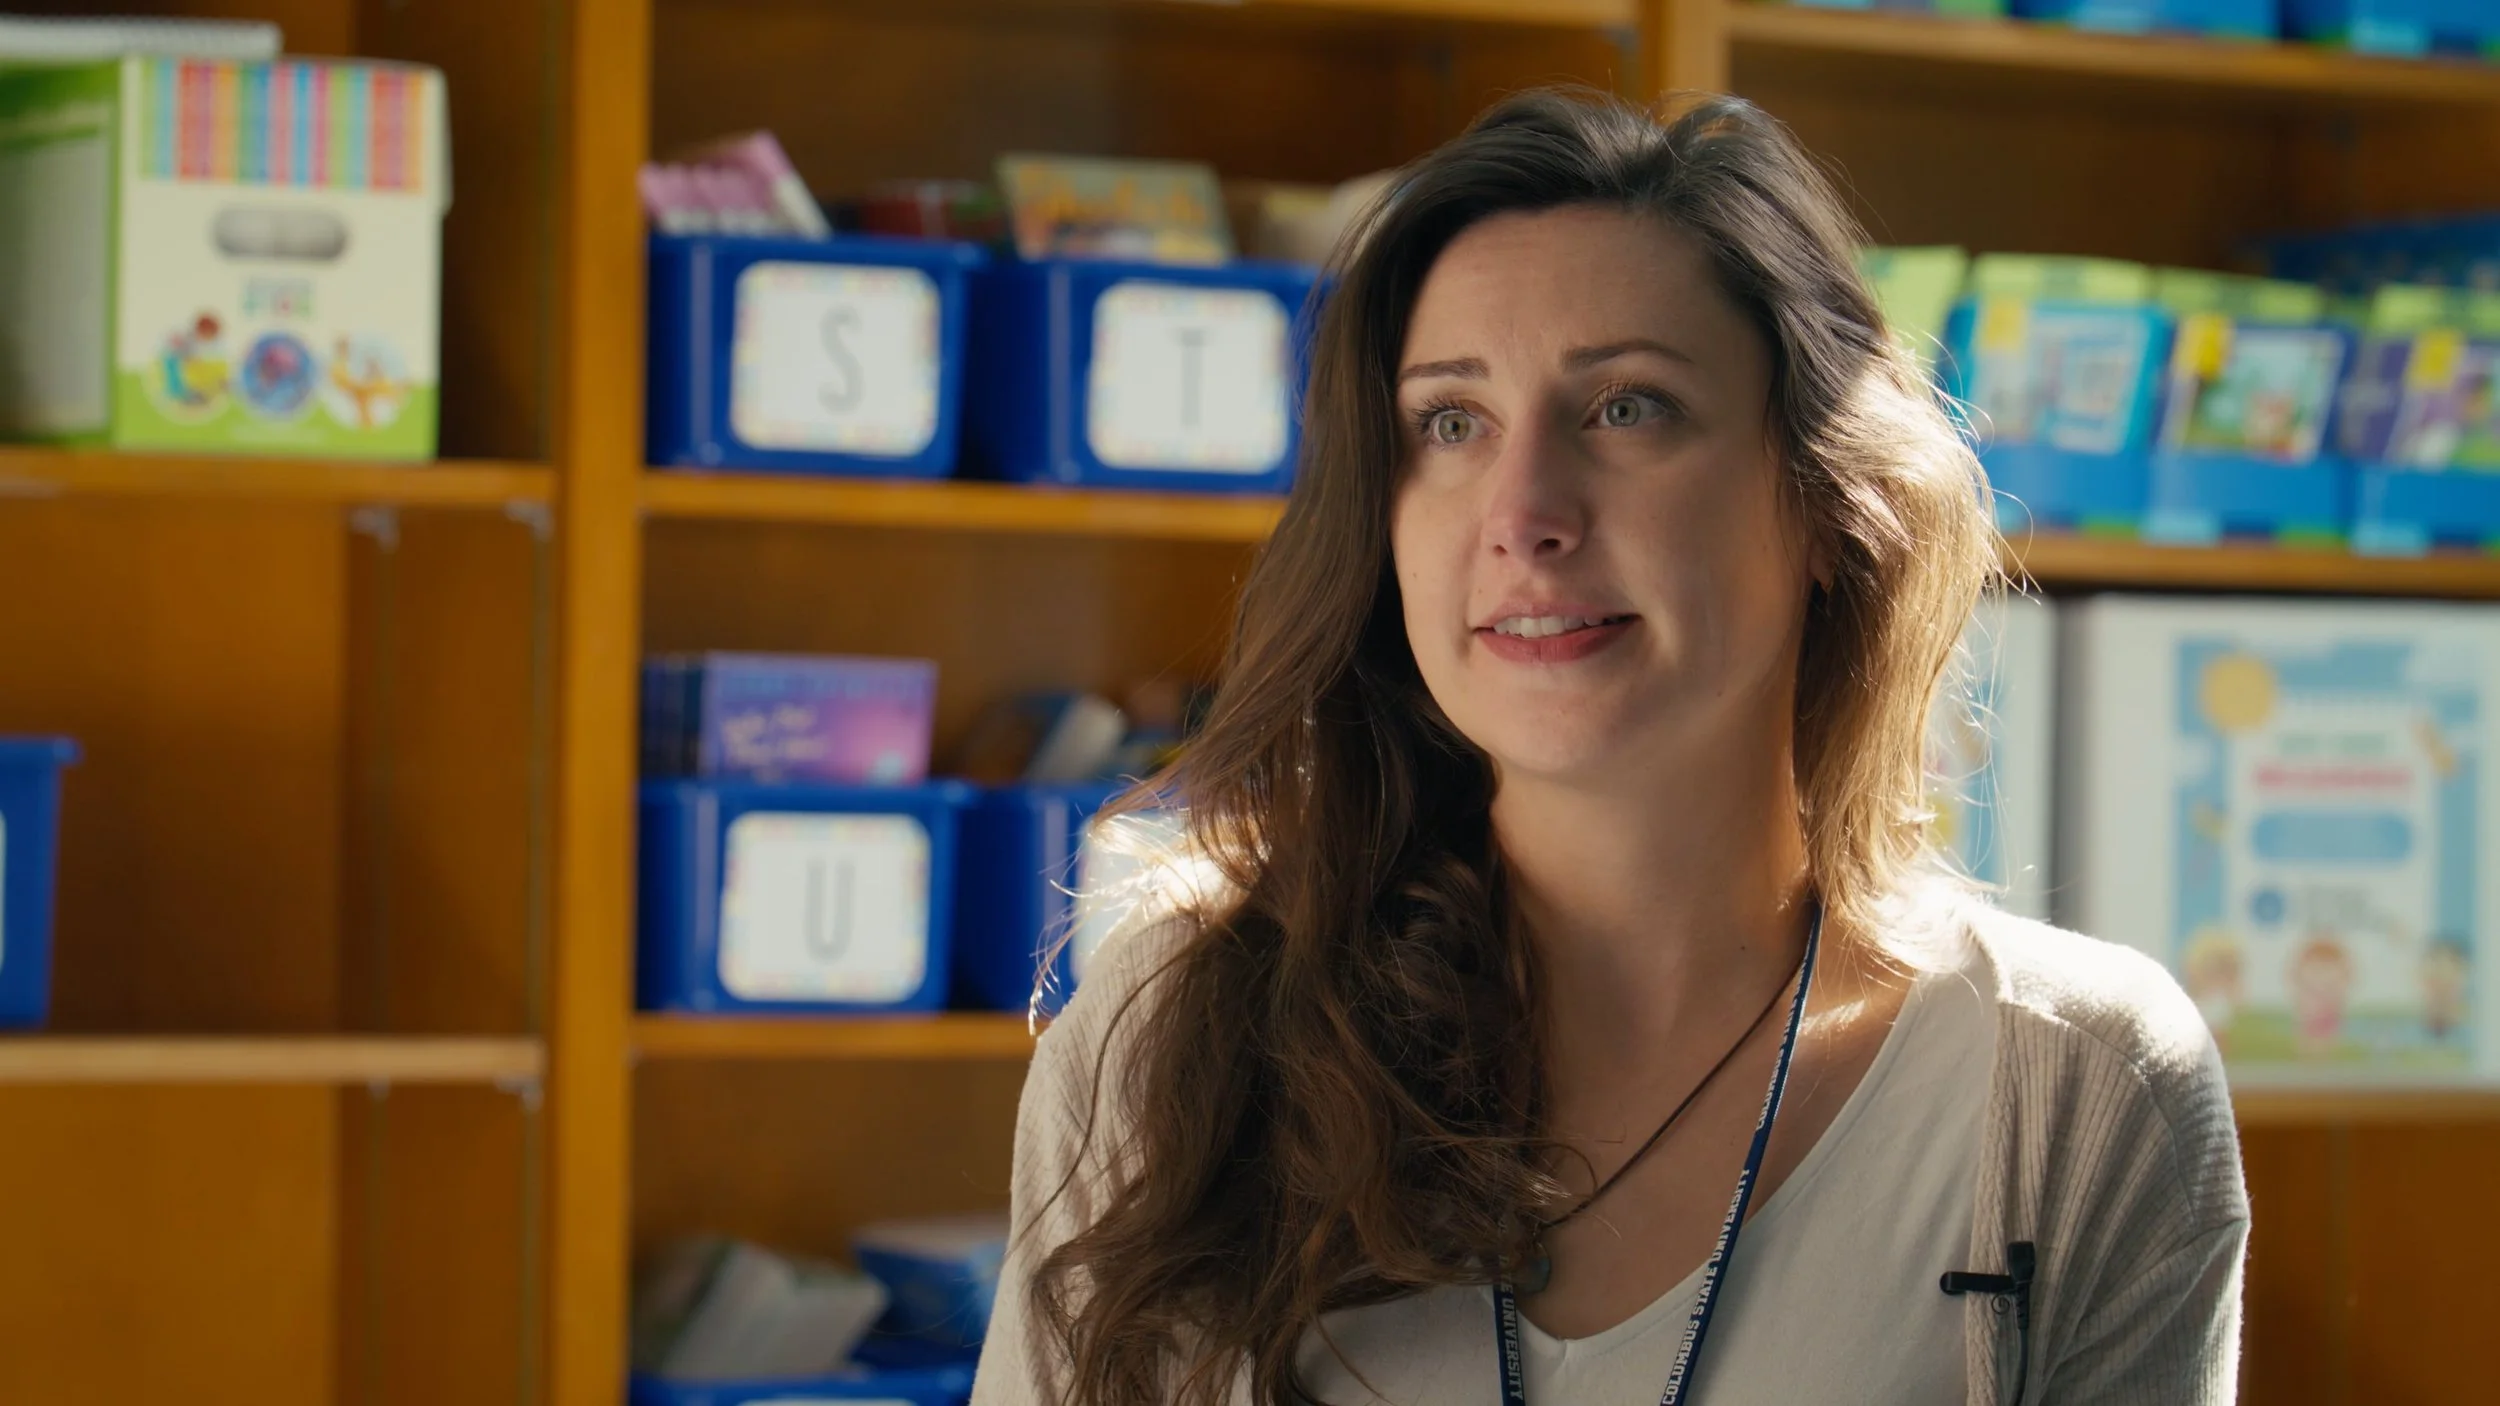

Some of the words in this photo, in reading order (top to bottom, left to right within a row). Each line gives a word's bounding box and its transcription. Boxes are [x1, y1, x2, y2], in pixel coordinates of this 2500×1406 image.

[817, 304, 863, 414] S
[1173, 326, 1211, 427] T
[803, 857, 856, 962] U
[1662, 1319, 1701, 1405] COLUMBUS
[1692, 1266, 1718, 1316] STATE
[1711, 1168, 1750, 1262] UNIVERSITY
[1501, 1298, 1524, 1400] UNIVERSITY
